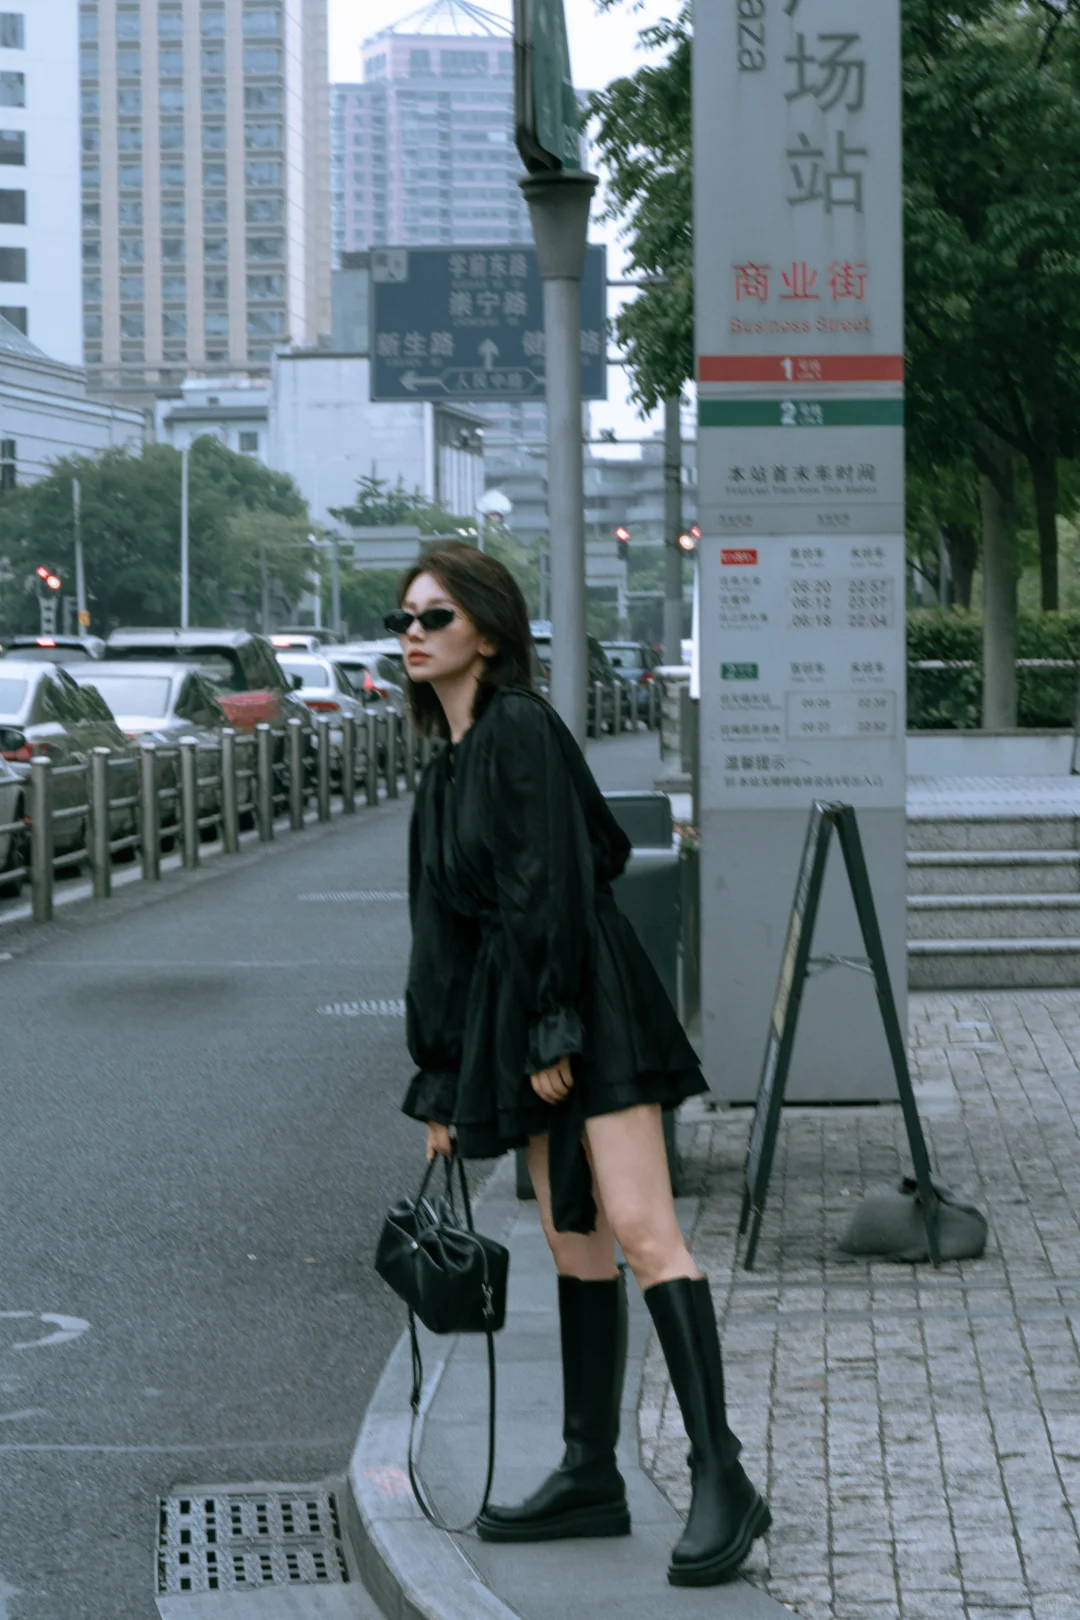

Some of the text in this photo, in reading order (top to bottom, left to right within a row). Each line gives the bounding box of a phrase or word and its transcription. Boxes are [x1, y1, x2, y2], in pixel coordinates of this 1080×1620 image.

[783, 0, 868, 214] 场站
[732, 261, 869, 302] 商业街
[729, 316, 871, 334] Business Street
[728, 463, 876, 483] 本站首末车时间
[724, 755, 786, 771] 温馨提示
